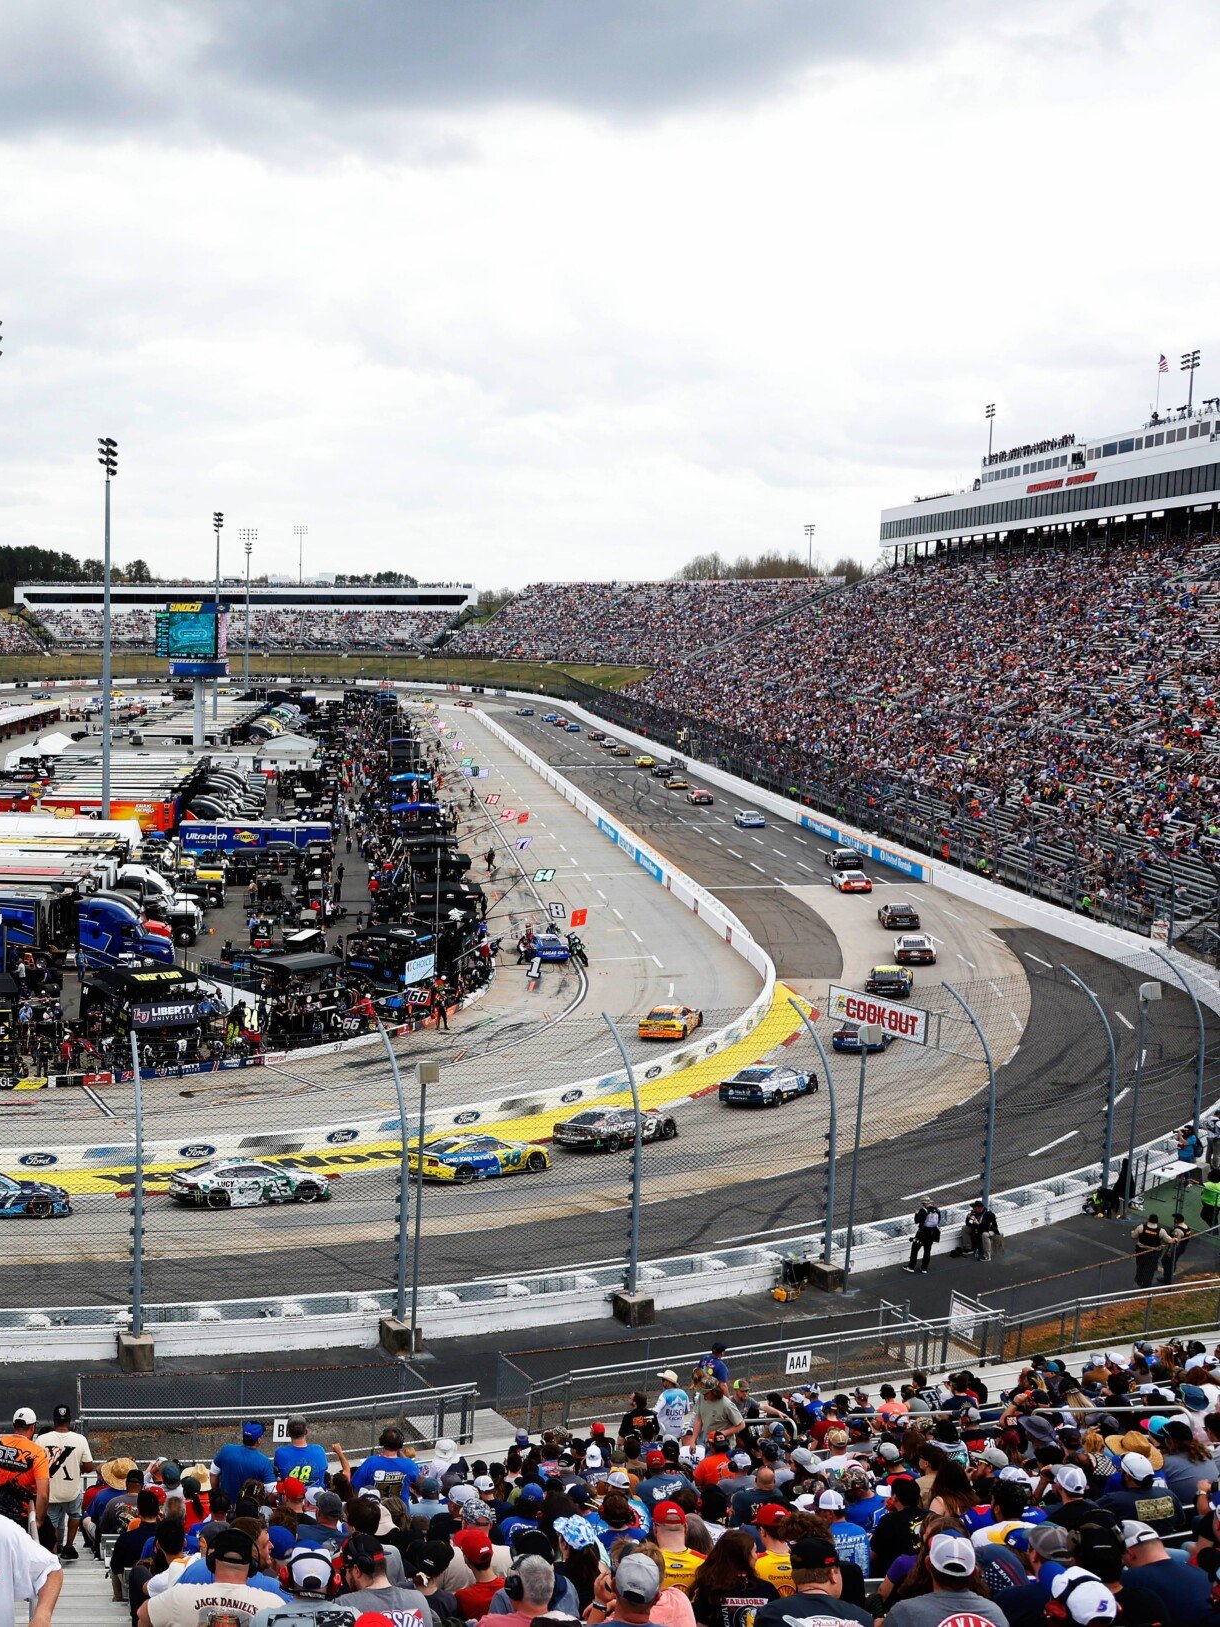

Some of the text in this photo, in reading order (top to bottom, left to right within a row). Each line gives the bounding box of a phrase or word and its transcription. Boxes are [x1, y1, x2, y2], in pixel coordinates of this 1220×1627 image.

[168, 603, 202, 612] SUNOCO
[39, 768, 48, 777] 3
[486, 794, 500, 804] 19
[533, 868, 555, 882] 54
[549, 903, 565, 918] 8
[413, 957, 432, 970] CHOICE
[526, 957, 541, 979] 1
[409, 991, 428, 1003] 66
[152, 1005, 195, 1017] LIBERTY
[846, 998, 919, 1036] COOK OUT
[152, 1013, 195, 1022] UNIVERSITY
[244, 1007, 258, 1032] 24
[342, 1017, 360, 1030] 66
[644, 1119, 657, 1137] 3
[332, 1131, 354, 1142] Ford
[185, 1145, 211, 1157] Ford
[26, 1154, 52, 1165] Ford
[502, 1149, 522, 1167] 38
[268, 1179, 292, 1197] 35
[789, 1355, 808, 1370] AAA
[666, 1408, 686, 1417] BUSCH
[289, 1465, 312, 1480] 48
[374, 1470, 385, 1482] 9
[385, 1474, 407, 1482] ELLIOTT
[194, 1597, 260, 1616] JACK DANIEL'S
[1097, 1600, 1109, 1611] 5
